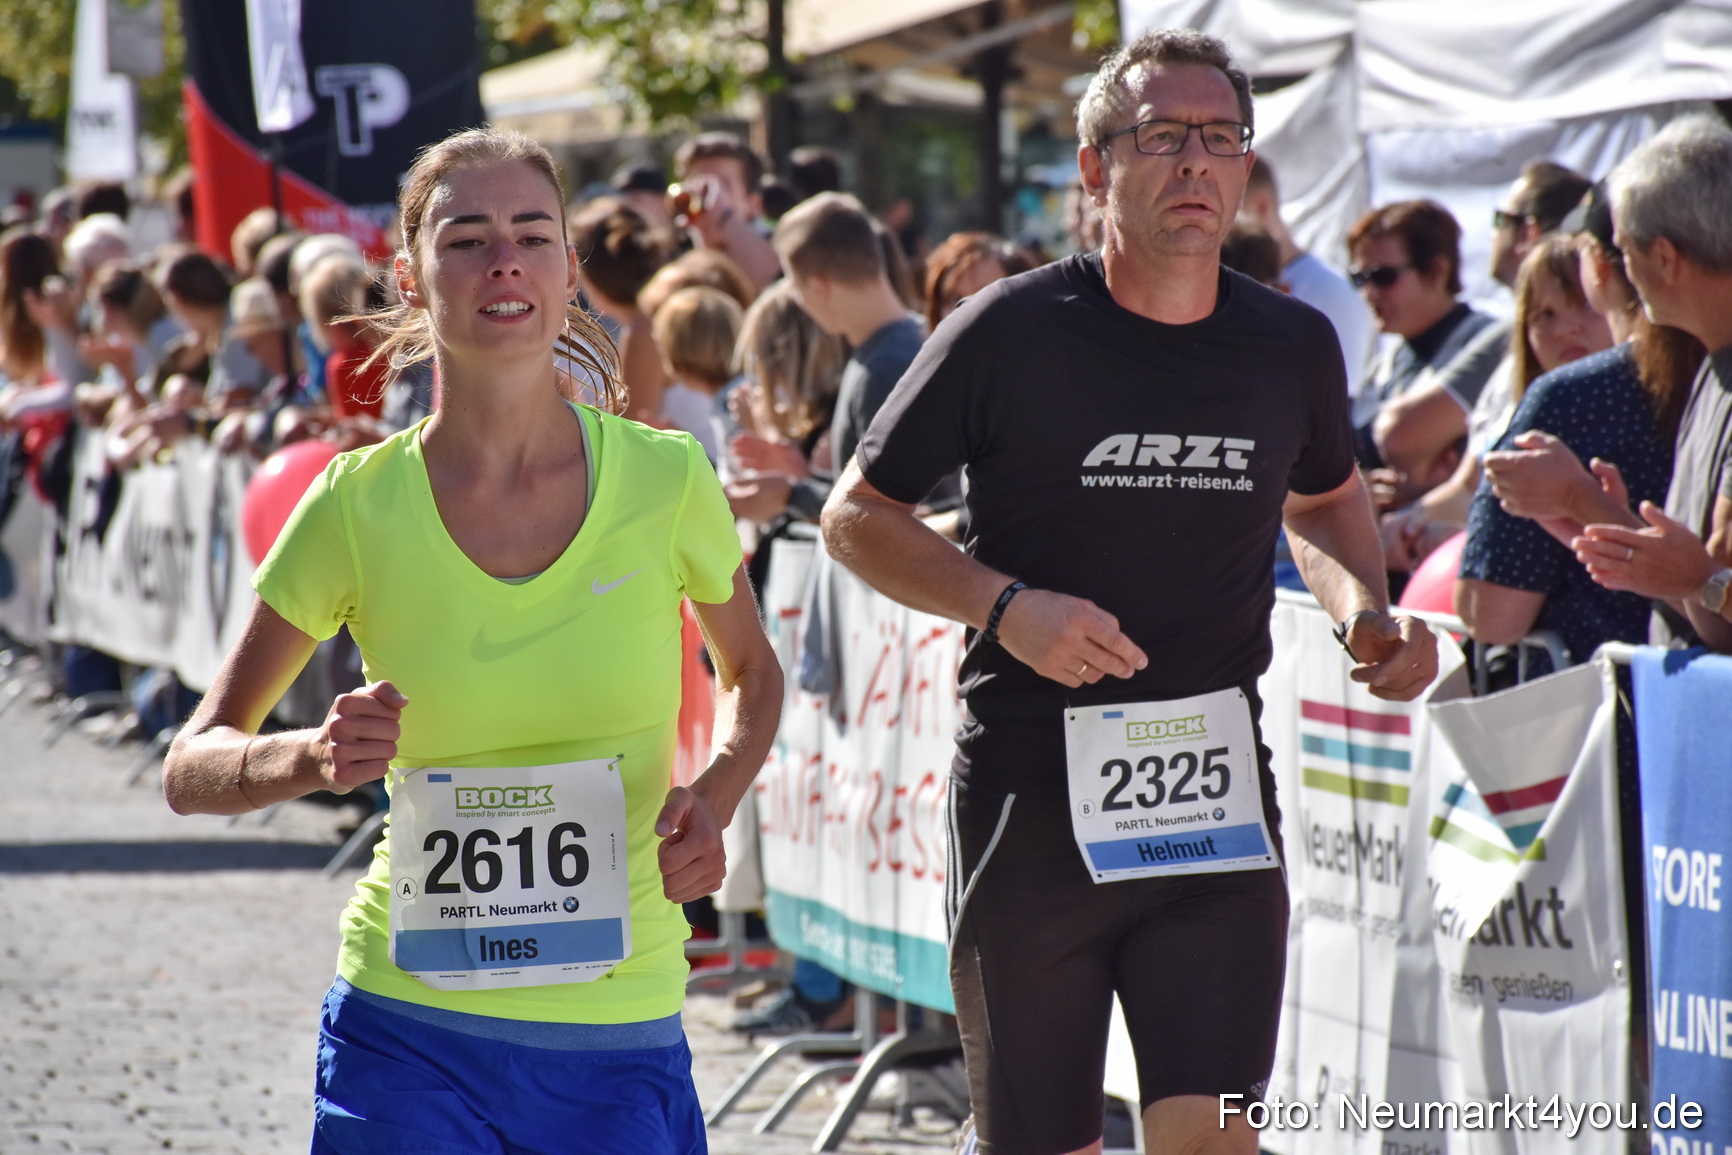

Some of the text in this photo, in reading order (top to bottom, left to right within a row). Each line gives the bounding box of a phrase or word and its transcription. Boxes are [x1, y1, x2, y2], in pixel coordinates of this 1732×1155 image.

[1082, 433, 1255, 470] ARZT
[1081, 473, 1254, 491] www.arzt-reisen.de
[1126, 714, 1207, 741] BOCK
[1126, 740, 1153, 748] inspired
[1100, 746, 1231, 812] 2325
[455, 785, 555, 809] BOCK
[455, 811, 485, 819] inspired
[522, 807, 556, 817] concepts
[1083, 804, 1090, 814] B
[1115, 819, 1154, 831] PARTL
[1155, 812, 1209, 827] Neumarkt
[423, 822, 590, 895] 2616
[1137, 836, 1217, 863] Helmut
[402, 883, 411, 895] A
[440, 905, 486, 919] PARTL
[489, 901, 558, 916] Neumarkt
[479, 935, 539, 962] Ines
